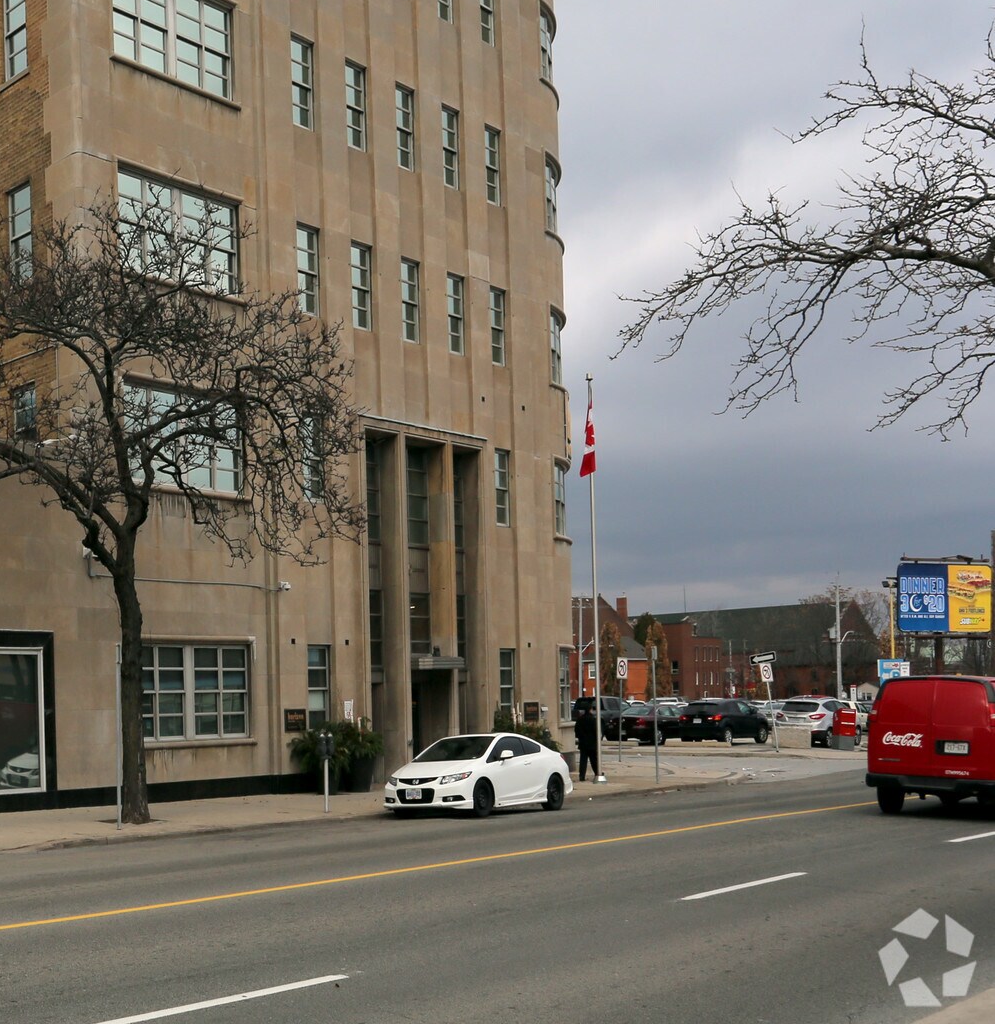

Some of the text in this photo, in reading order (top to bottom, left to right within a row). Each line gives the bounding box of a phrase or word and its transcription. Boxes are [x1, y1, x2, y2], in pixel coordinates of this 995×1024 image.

[900, 576, 945, 594] DINNER
[900, 594, 909, 612] 3
[923, 594, 945, 612] $20
[882, 731, 924, 748] Coca-Cola
